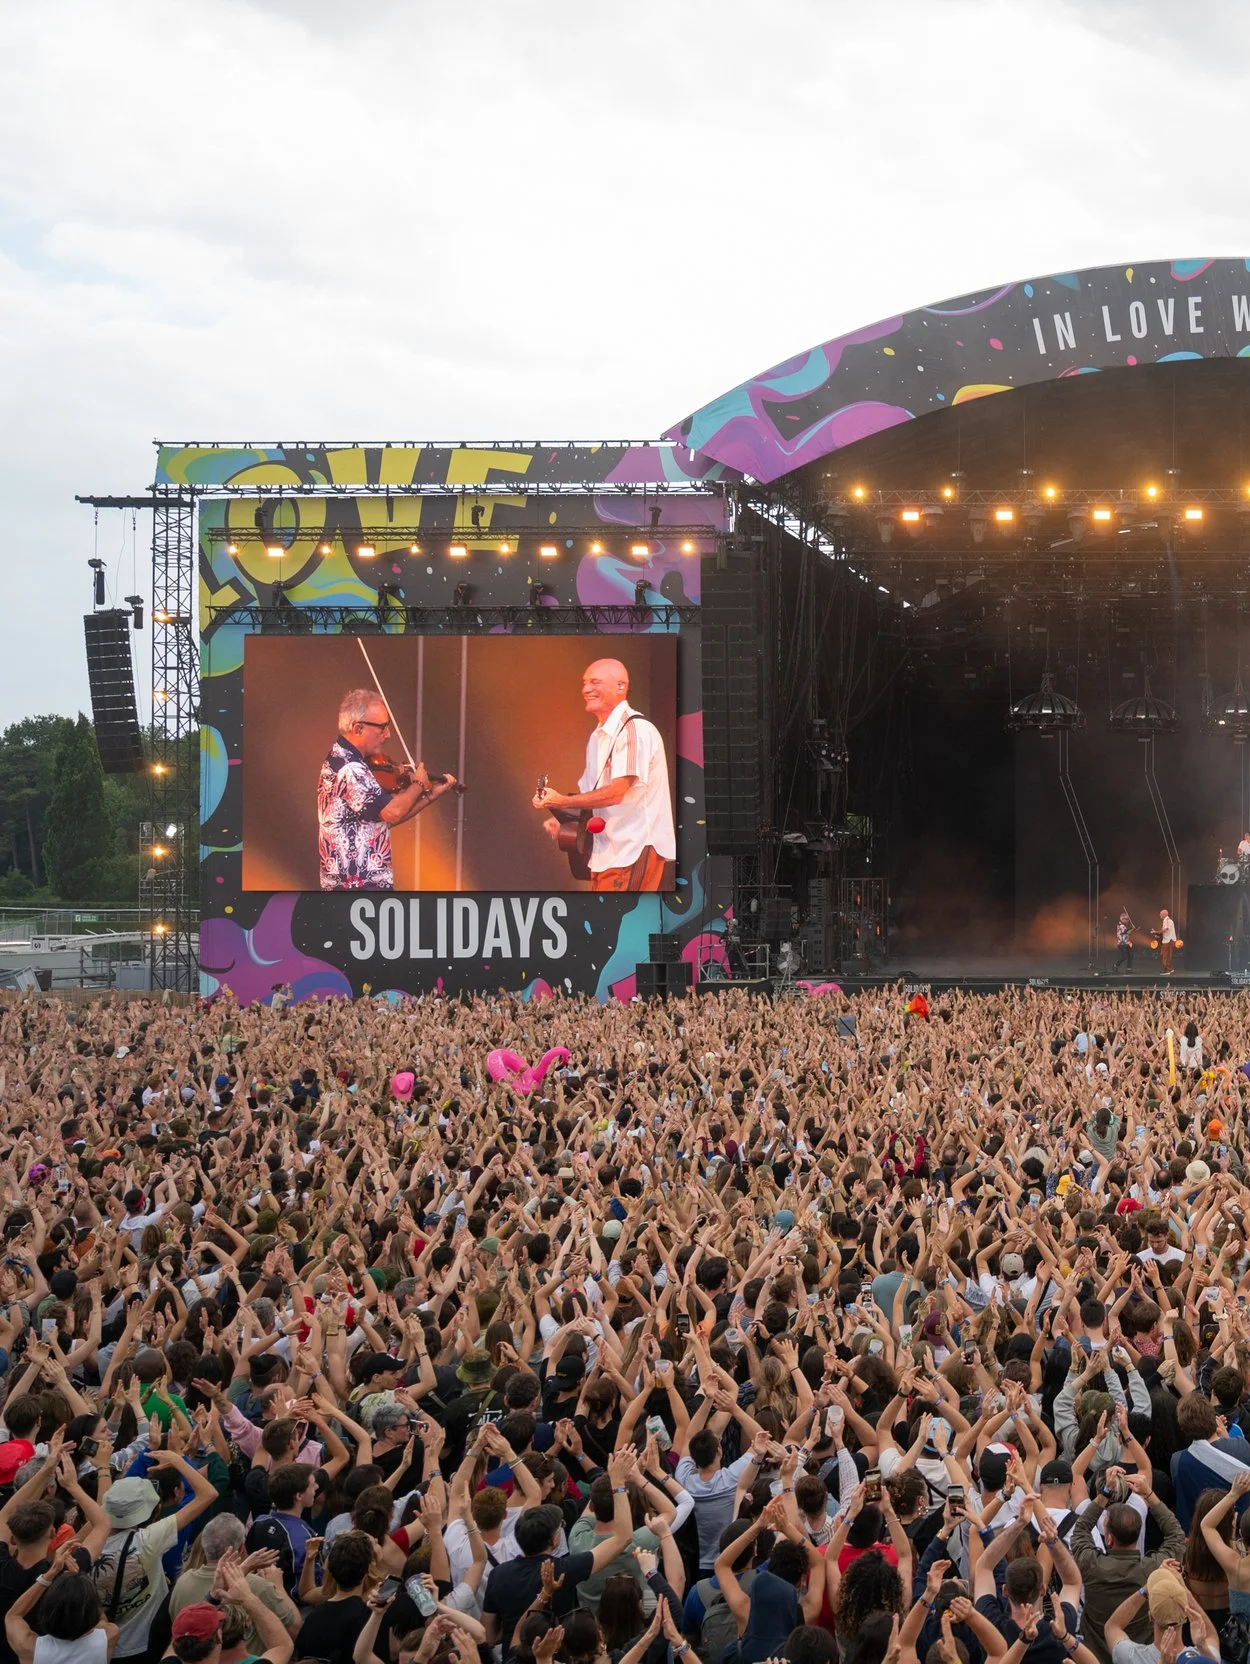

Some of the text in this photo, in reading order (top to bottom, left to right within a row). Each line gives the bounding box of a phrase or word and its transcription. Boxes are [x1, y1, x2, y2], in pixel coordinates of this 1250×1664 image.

[1032, 312, 1077, 354] IN
[1102, 296, 1205, 343] LOVE
[350, 897, 568, 960] SOLIDAYS
